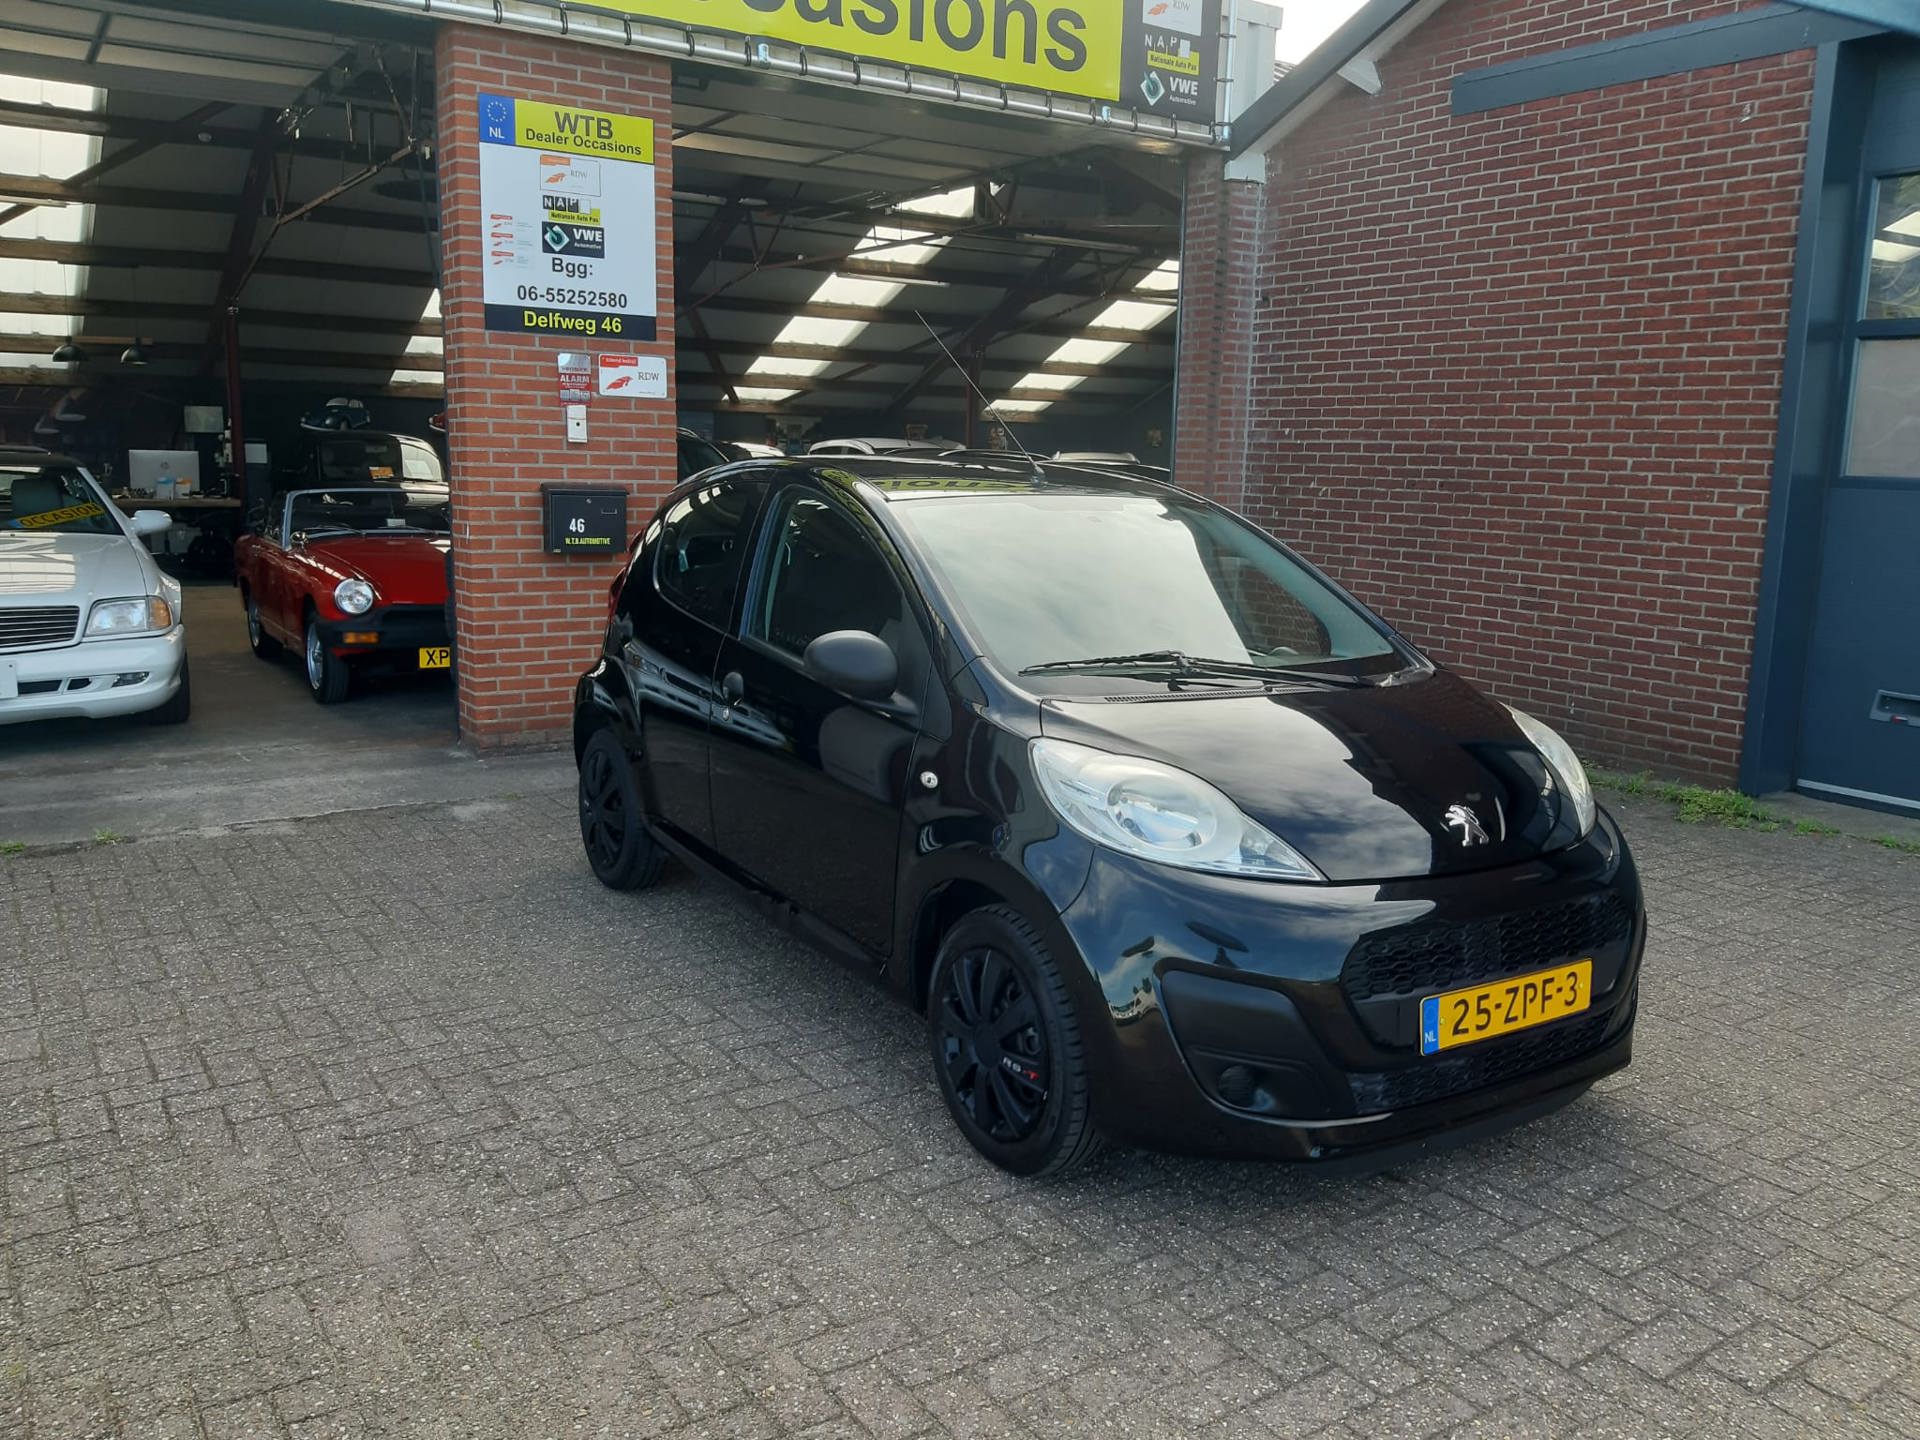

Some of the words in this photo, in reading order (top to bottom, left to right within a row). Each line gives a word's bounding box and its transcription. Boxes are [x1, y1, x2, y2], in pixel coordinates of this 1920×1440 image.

[1169, 76, 1199, 96] VWE
[489, 126, 505, 139] NL
[555, 111, 613, 139] WTB
[526, 128, 569, 146] Dealer
[573, 135, 642, 156] Occasions
[573, 228, 603, 242] VWE
[552, 257, 593, 279] Bgg:
[517, 285, 628, 309] 06-55252580
[523, 311, 597, 335] Delfweg
[601, 317, 622, 333] 46
[560, 374, 590, 383] ALARM
[638, 371, 660, 381] RDW
[20, 503, 101, 527] OCCASION
[569, 518, 585, 533] 46
[1451, 971, 1579, 1037] 25-ZPF-3
[1424, 1030, 1436, 1044] NL
